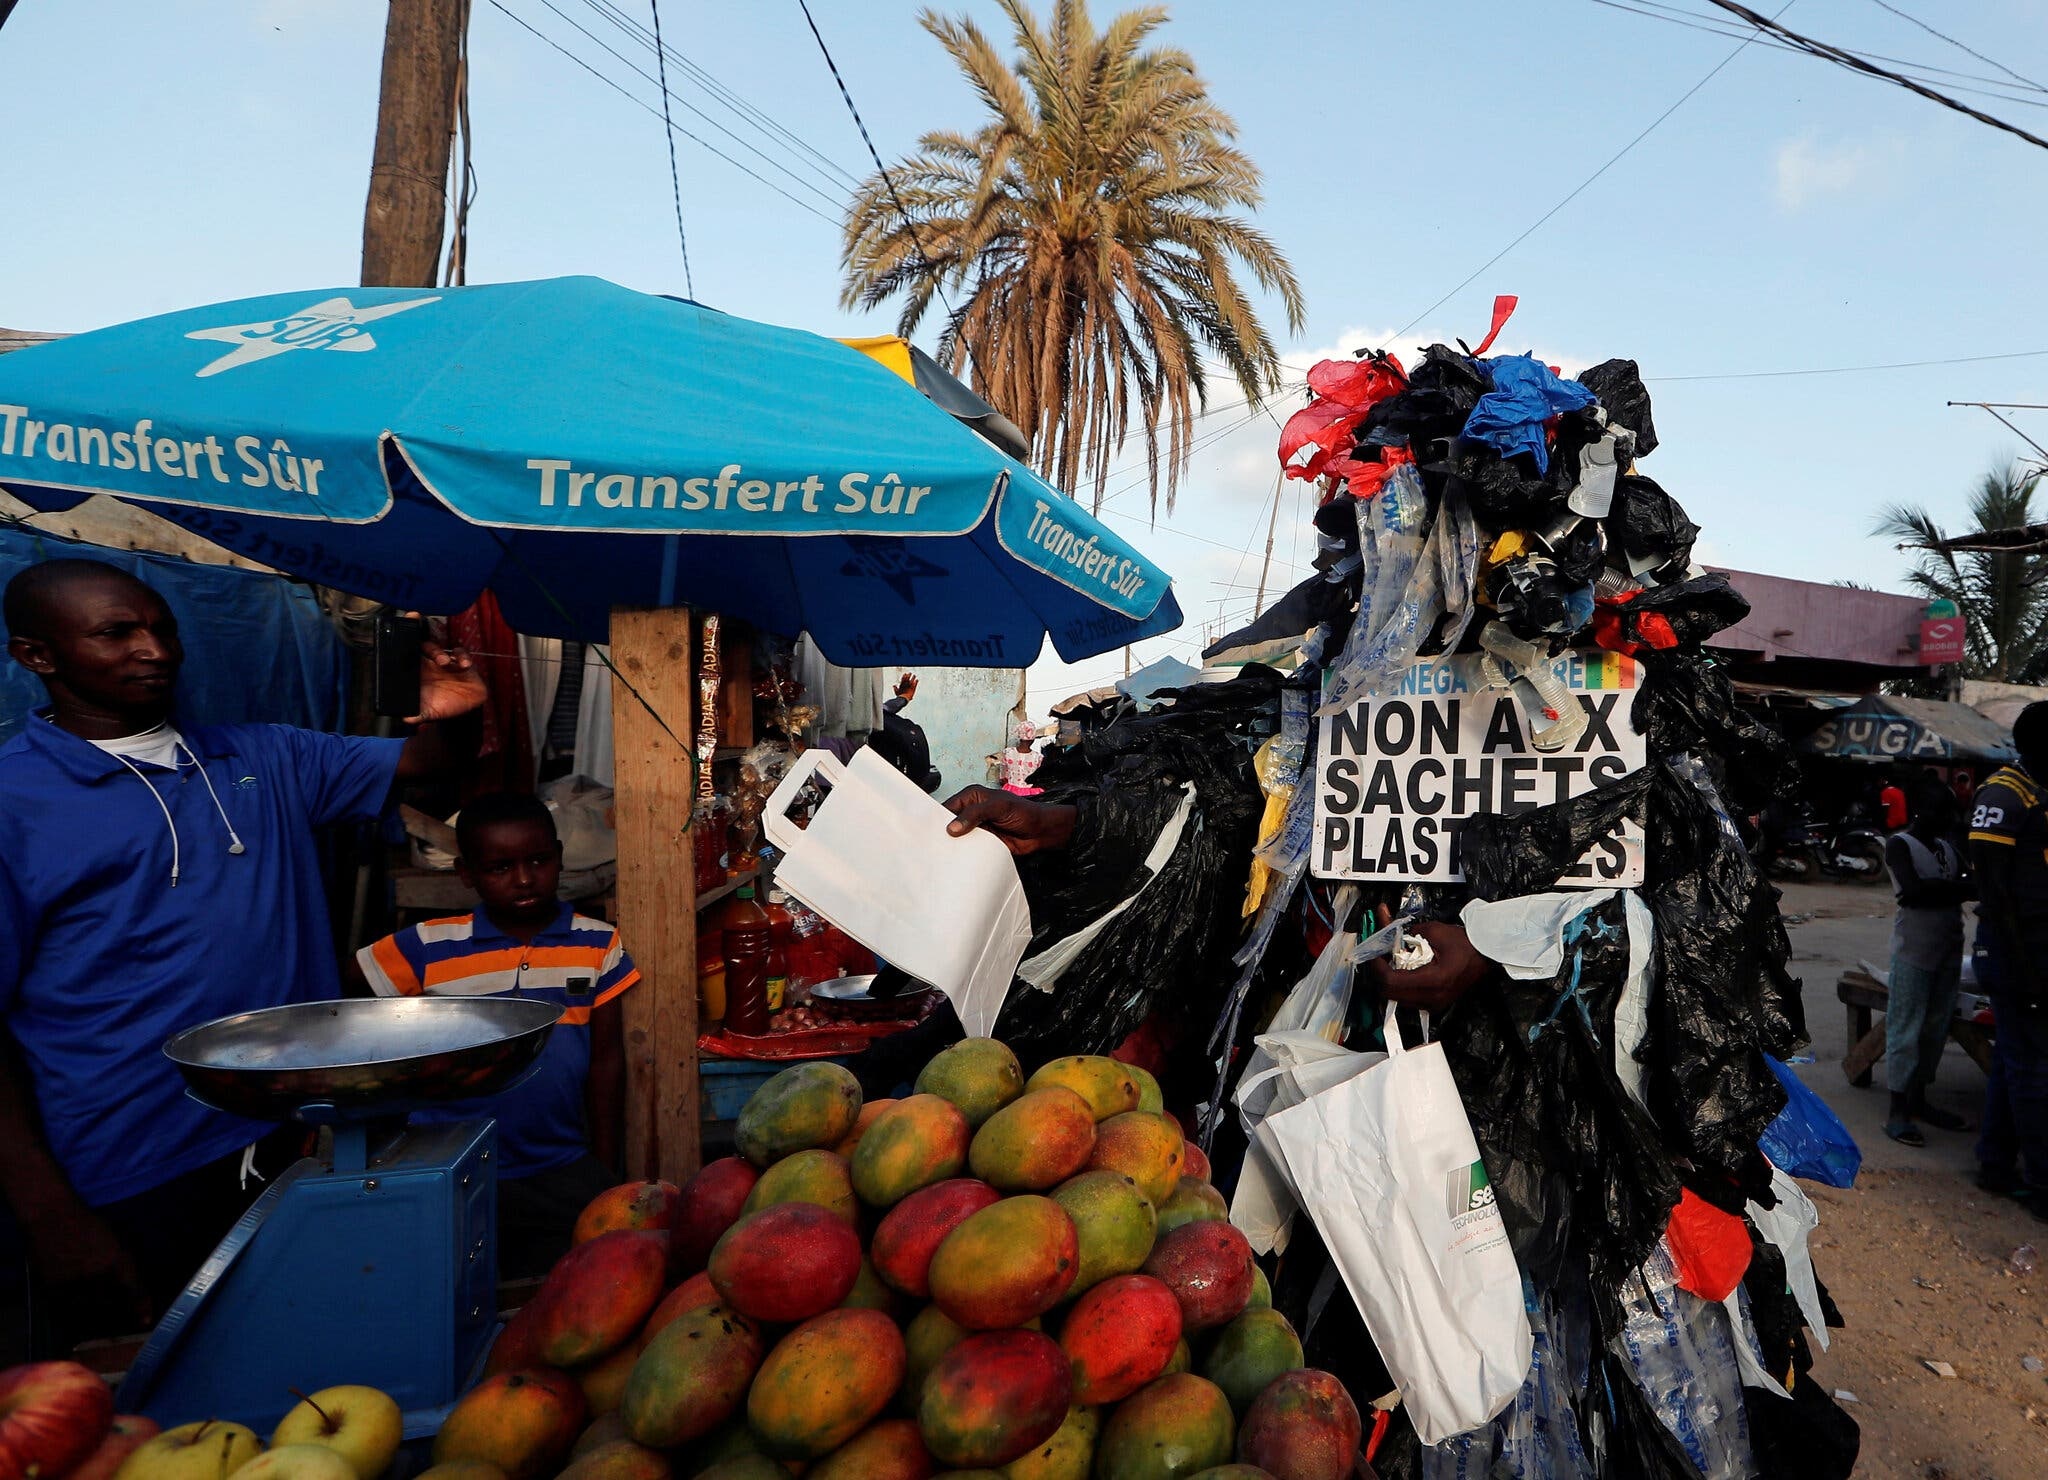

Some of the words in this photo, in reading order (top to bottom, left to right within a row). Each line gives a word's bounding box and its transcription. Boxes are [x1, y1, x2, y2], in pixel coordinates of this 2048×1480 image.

[0, 404, 230, 483] Transfert
[234, 435, 324, 496] Sûr
[527, 459, 824, 512] Transfert
[834, 472, 931, 515] Sûr
[1026, 499, 1119, 585] Transfert
[1110, 559, 1146, 600] Sûr
[1368, 664, 1468, 697] NEGA
[1329, 699, 1460, 755] NON
[1481, 694, 1621, 754] AX
[1815, 720, 1946, 754] SUGA
[1323, 755, 1628, 815] SACHETS
[1971, 804, 2004, 828] 82
[1322, 816, 1628, 879] PLASTS
